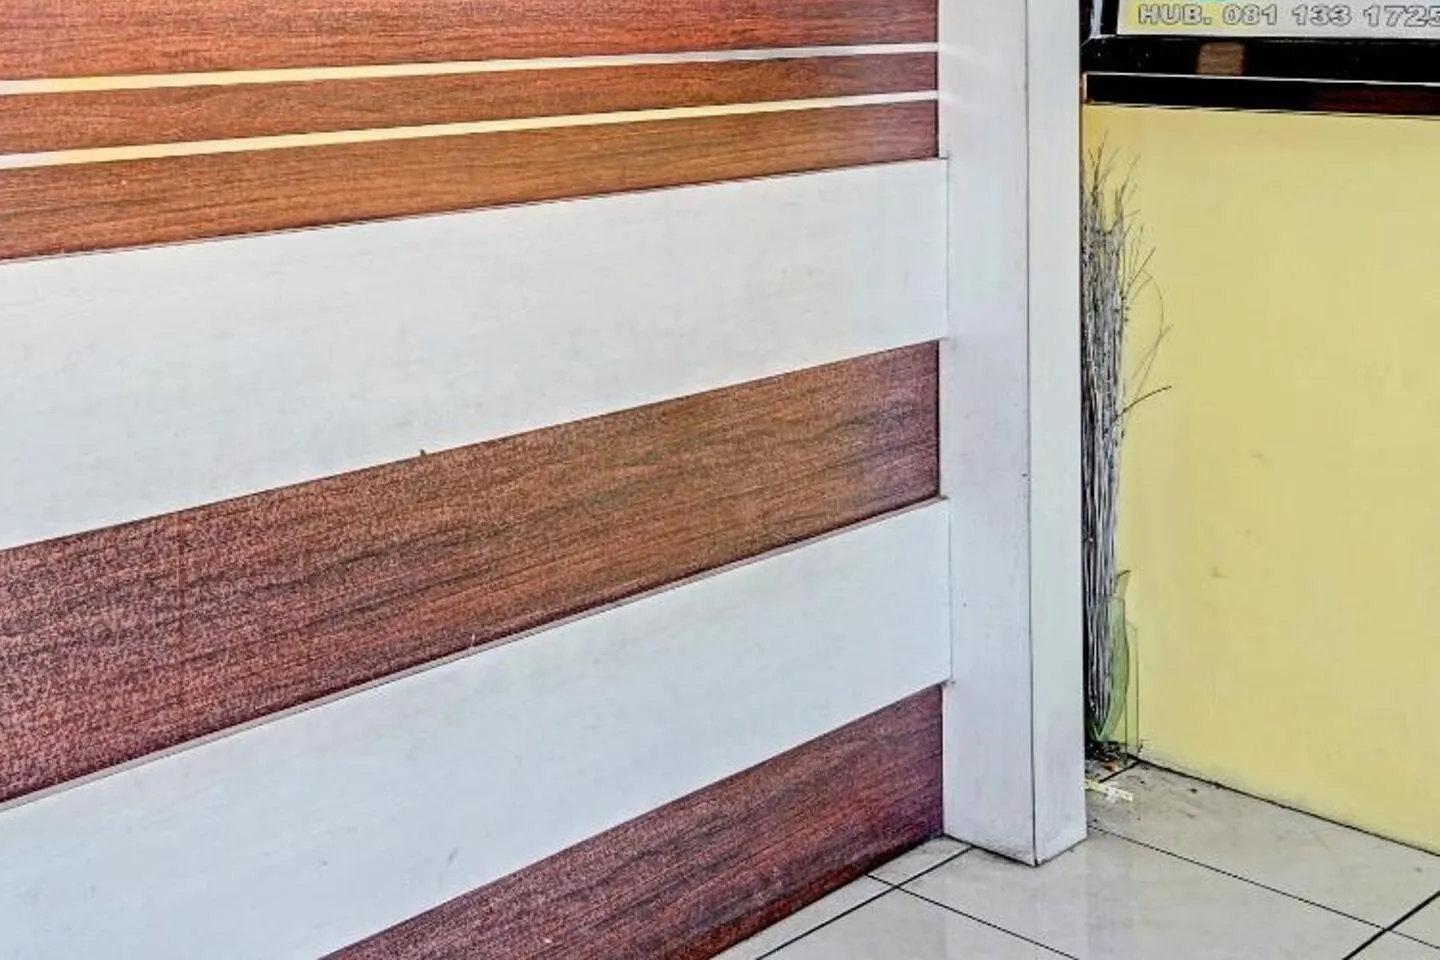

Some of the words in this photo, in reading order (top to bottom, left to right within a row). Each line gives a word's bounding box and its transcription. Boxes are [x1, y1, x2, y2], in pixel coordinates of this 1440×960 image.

[1137, 3, 1212, 26] HUB.
[1222, 4, 1278, 26] 081
[1292, 4, 1353, 27] 133
